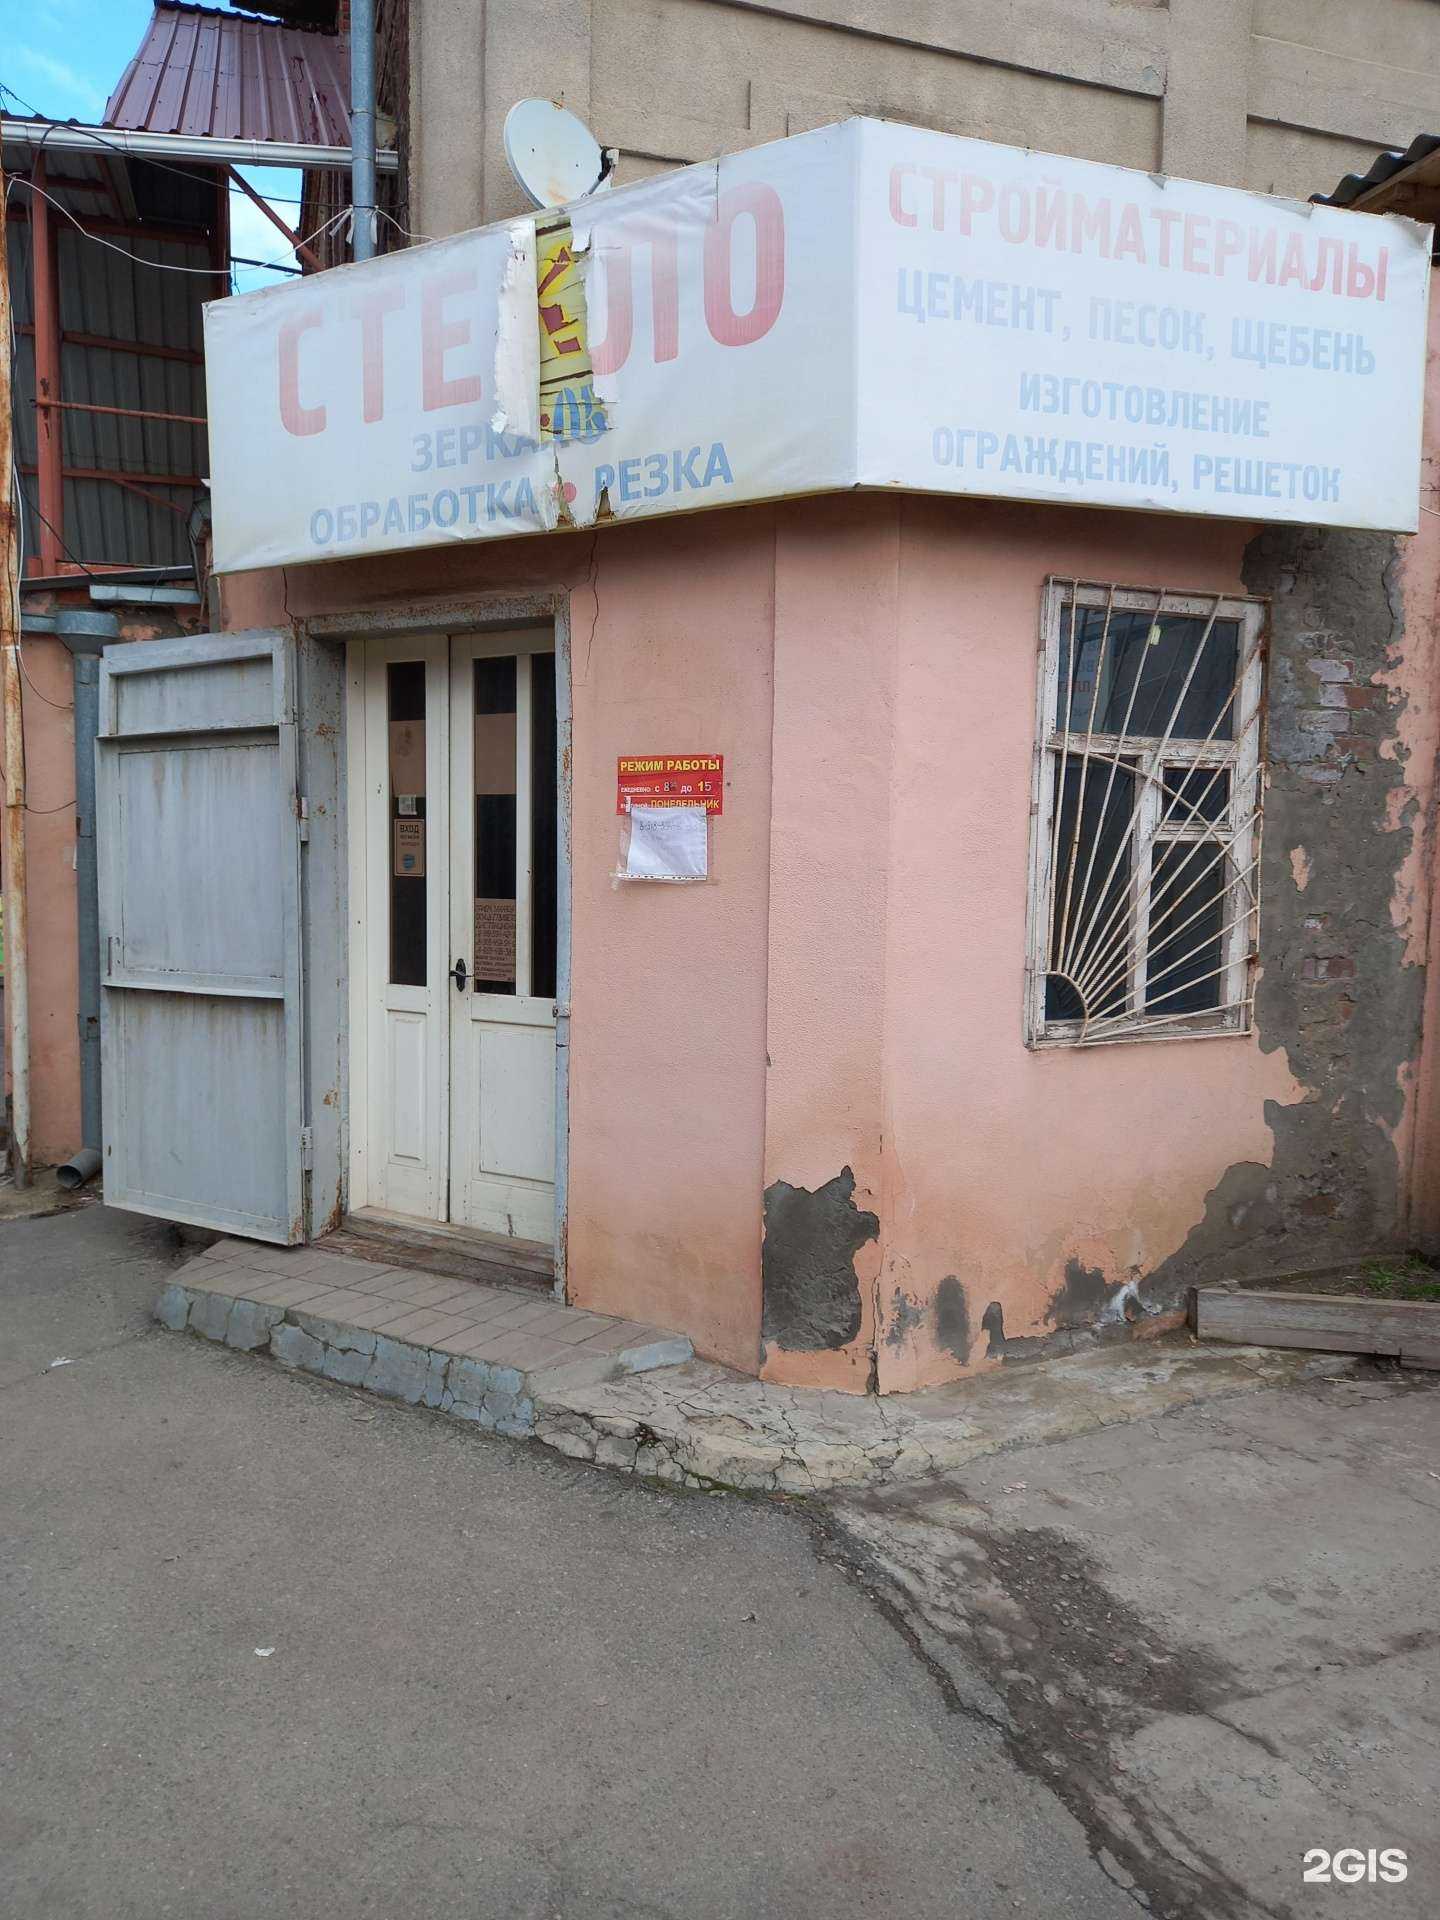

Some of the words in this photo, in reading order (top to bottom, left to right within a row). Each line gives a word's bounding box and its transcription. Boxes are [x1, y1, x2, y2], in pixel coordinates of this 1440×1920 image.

[889, 161, 1389, 301] СТРОЙМАТЕРИАЛЫ
[278, 181, 785, 436] СТЕЛО
[897, 268, 1071, 342] ЦЕМЕНТ,
[1088, 297, 1214, 362] ПЕСОК,
[1230, 317, 1376, 376] ЩЕБЕНЬ
[1019, 371, 1271, 438] ИЗГОТОВЛЕНИЕ
[310, 477, 540, 545] ОБРАБОТКА
[594, 443, 734, 502] РЕЗКА
[932, 426, 1178, 494] ОГРАЖДЕНИЙ,
[1192, 454, 1341, 503] РЕШЕТОК
[620, 761, 663, 772] РЕЖИМ
[667, 760, 720, 771] РАБОТЫ
